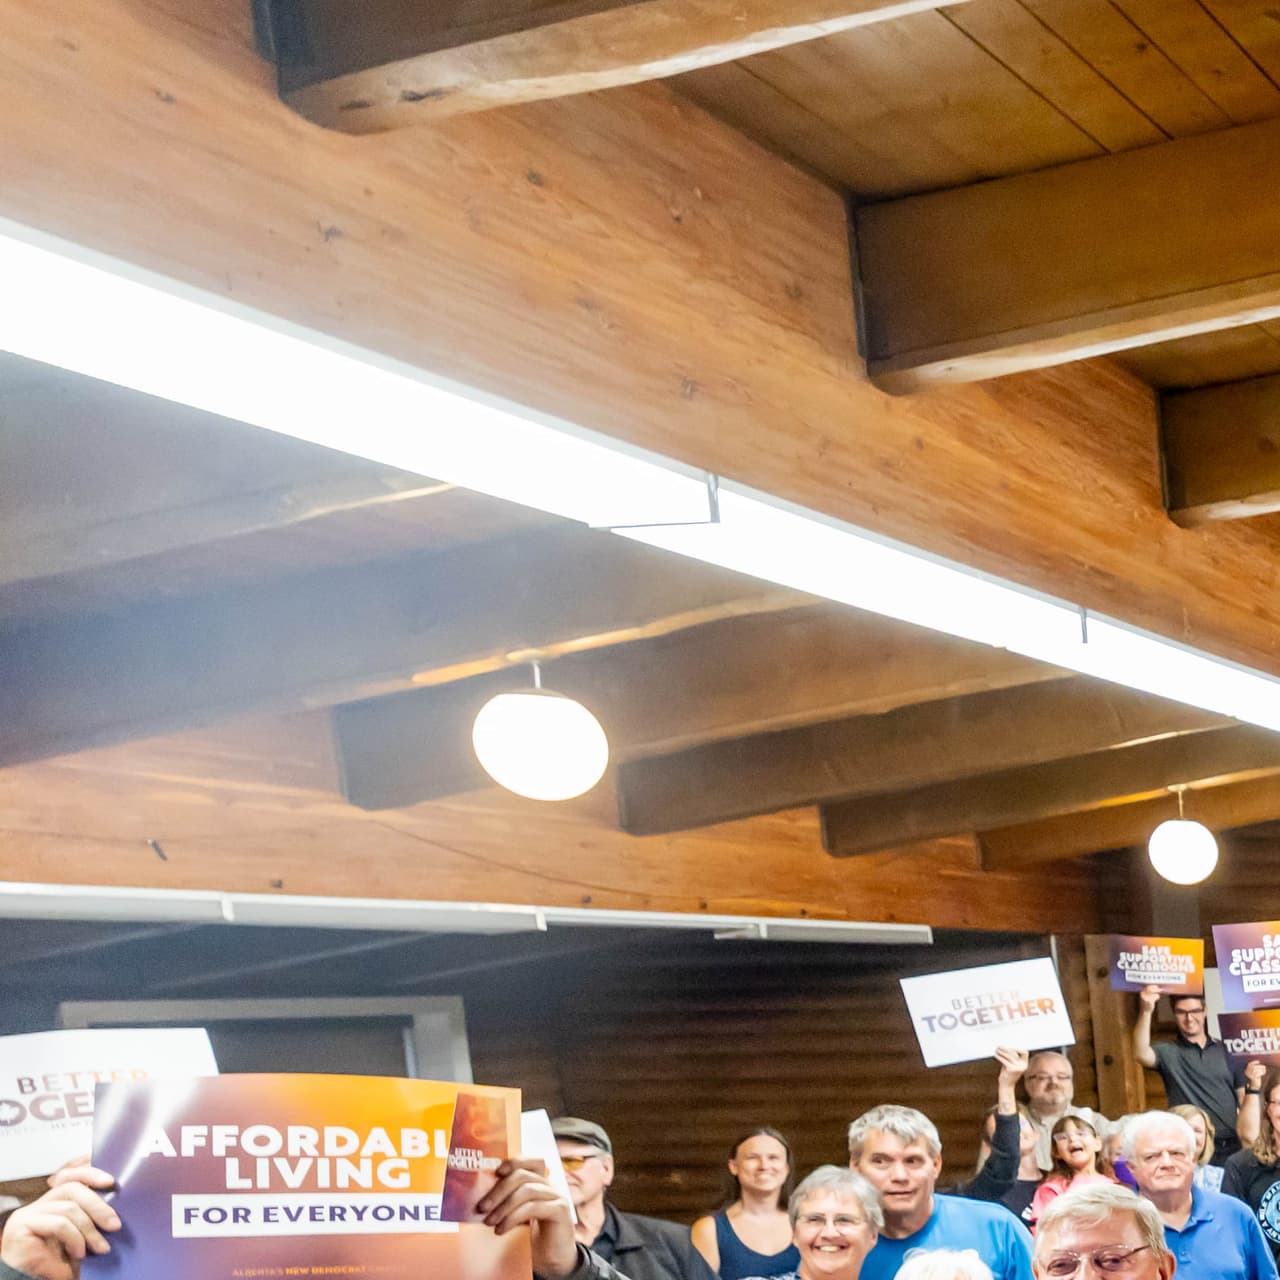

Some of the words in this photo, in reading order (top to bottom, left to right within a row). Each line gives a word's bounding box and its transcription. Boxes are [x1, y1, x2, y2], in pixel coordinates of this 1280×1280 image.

[1142, 944, 1171, 957] SAFE
[1247, 979, 1266, 987] FOR
[951, 991, 1021, 1010] BETTER
[922, 997, 1056, 1033] TOGETHER
[142, 1125, 450, 1158] AFFORDABL
[225, 1157, 411, 1190] LIVING
[184, 1207, 250, 1225] FOR
